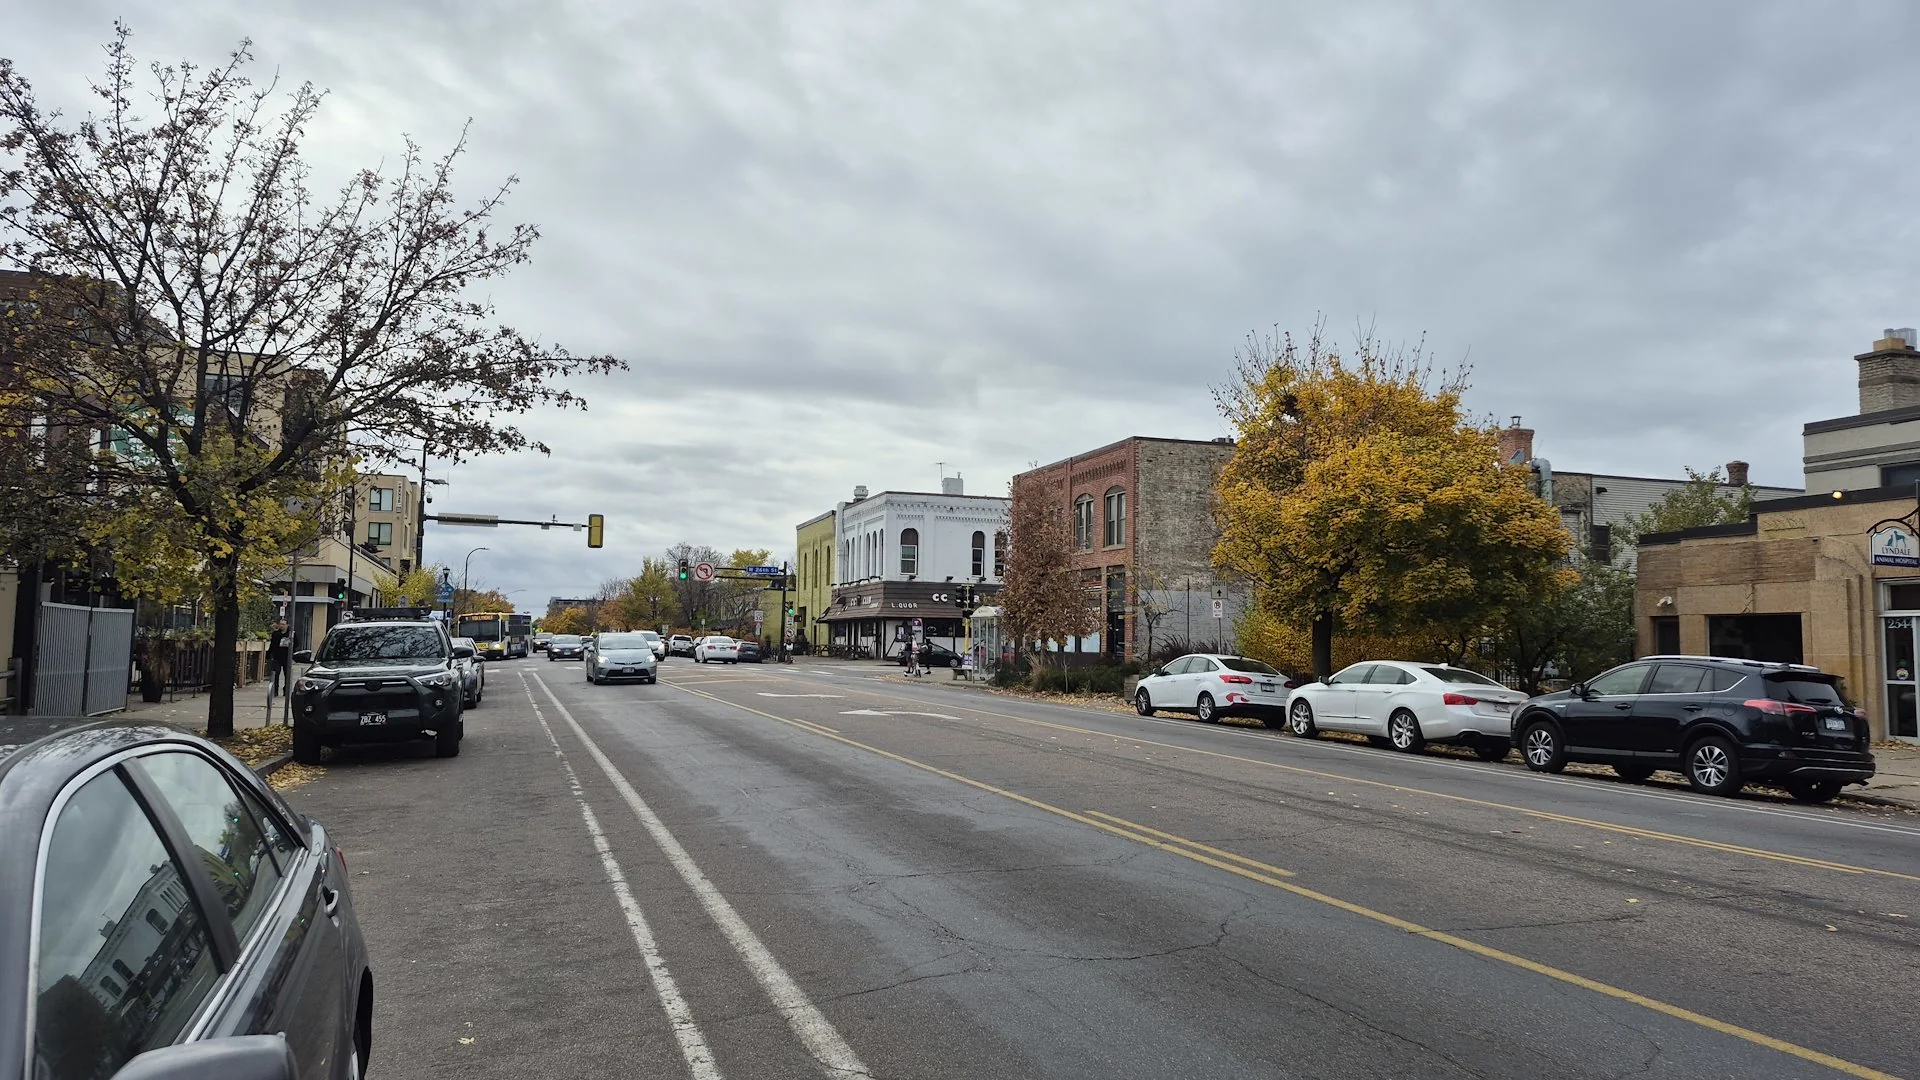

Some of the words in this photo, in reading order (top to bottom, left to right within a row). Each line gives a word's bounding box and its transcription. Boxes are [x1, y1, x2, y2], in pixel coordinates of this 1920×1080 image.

[1881, 546, 1912, 556] LYNDALE
[1875, 556, 1895, 564] ANIMAL
[1895, 557, 1918, 565] HOSPITAL
[932, 593, 948, 602] CC
